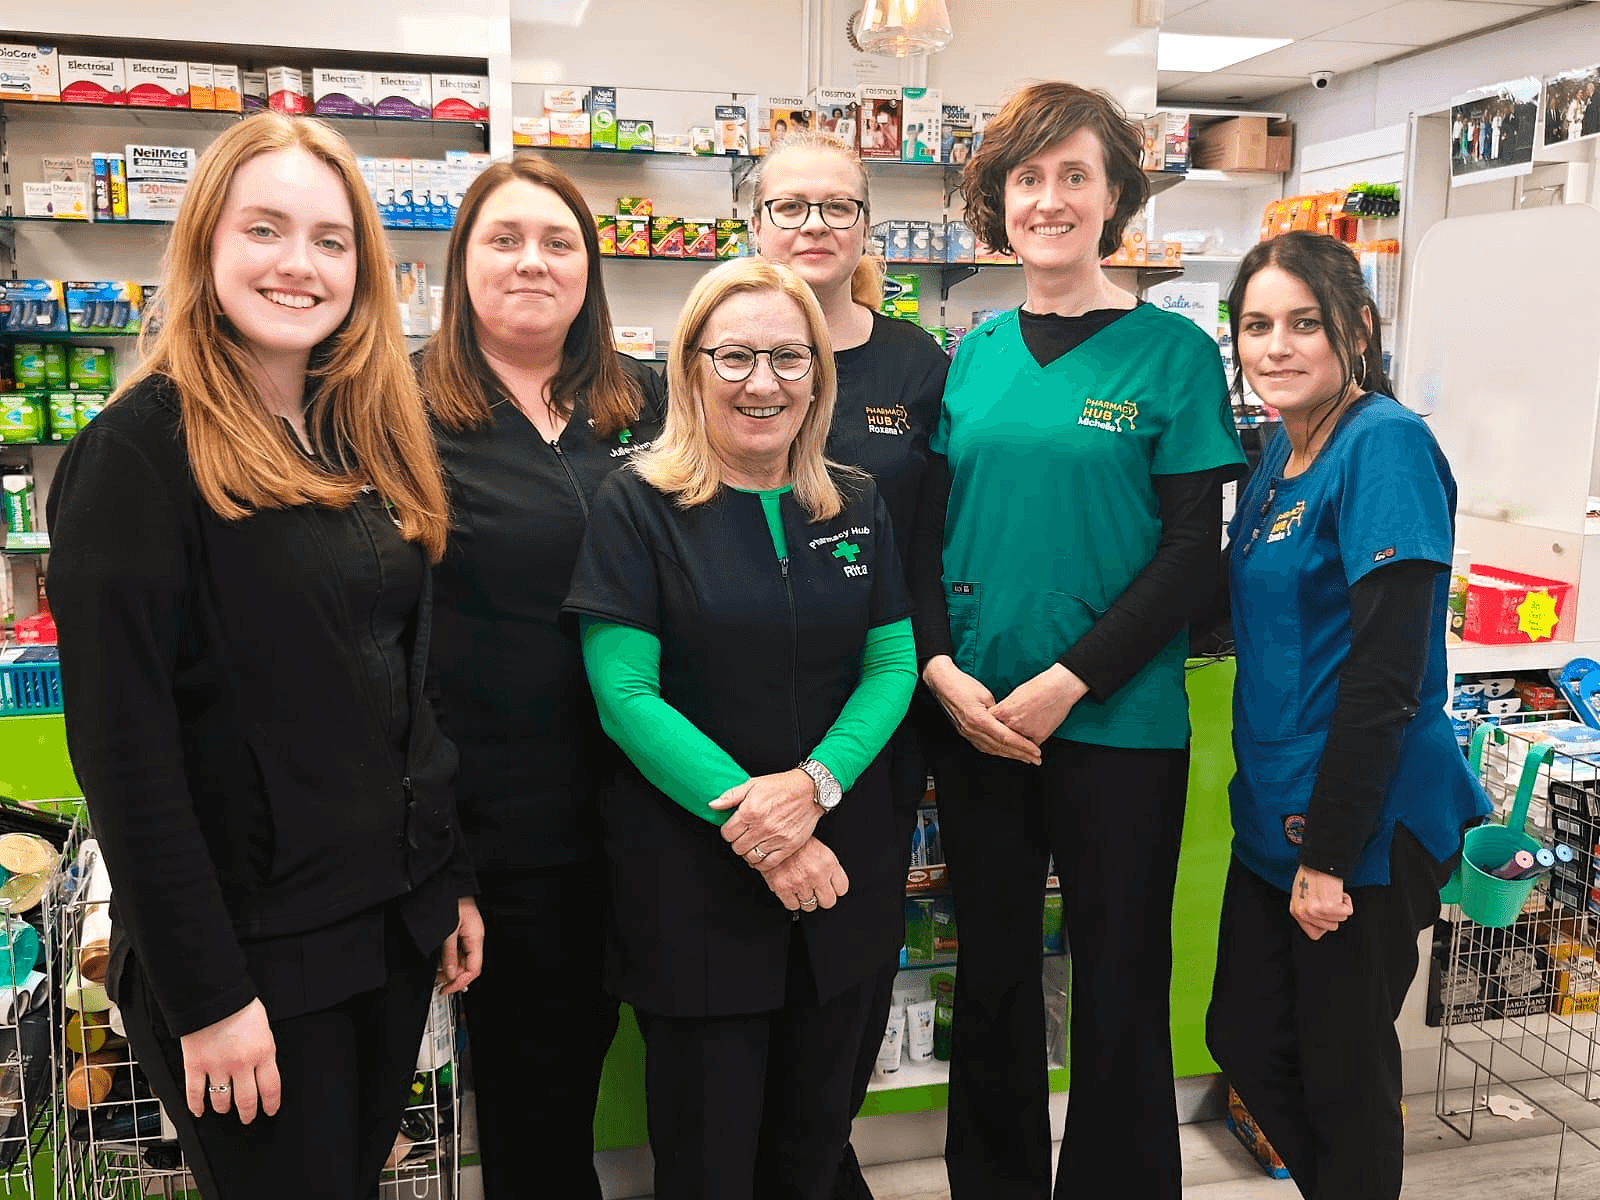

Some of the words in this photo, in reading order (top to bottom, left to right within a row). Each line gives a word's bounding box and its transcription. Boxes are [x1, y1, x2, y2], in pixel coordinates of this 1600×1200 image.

[68, 60, 114, 71] Electrosal
[133, 64, 178, 74] Electrosal
[440, 79, 481, 89] Electrosal
[821, 89, 856, 99] rossmax
[866, 87, 898, 97] rossmax
[769, 97, 803, 106] rossmax
[133, 147, 188, 159] NeilMed
[1085, 397, 1134, 415] PHARMACY
[1083, 406, 1112, 421] HUB
[867, 415, 893, 426] HUB
[1077, 416, 1116, 432] Michelle
[868, 424, 898, 435] Roxana
[808, 528, 849, 550] Pharmacy
[851, 525, 870, 535] Hub
[843, 563, 868, 578] Rita
